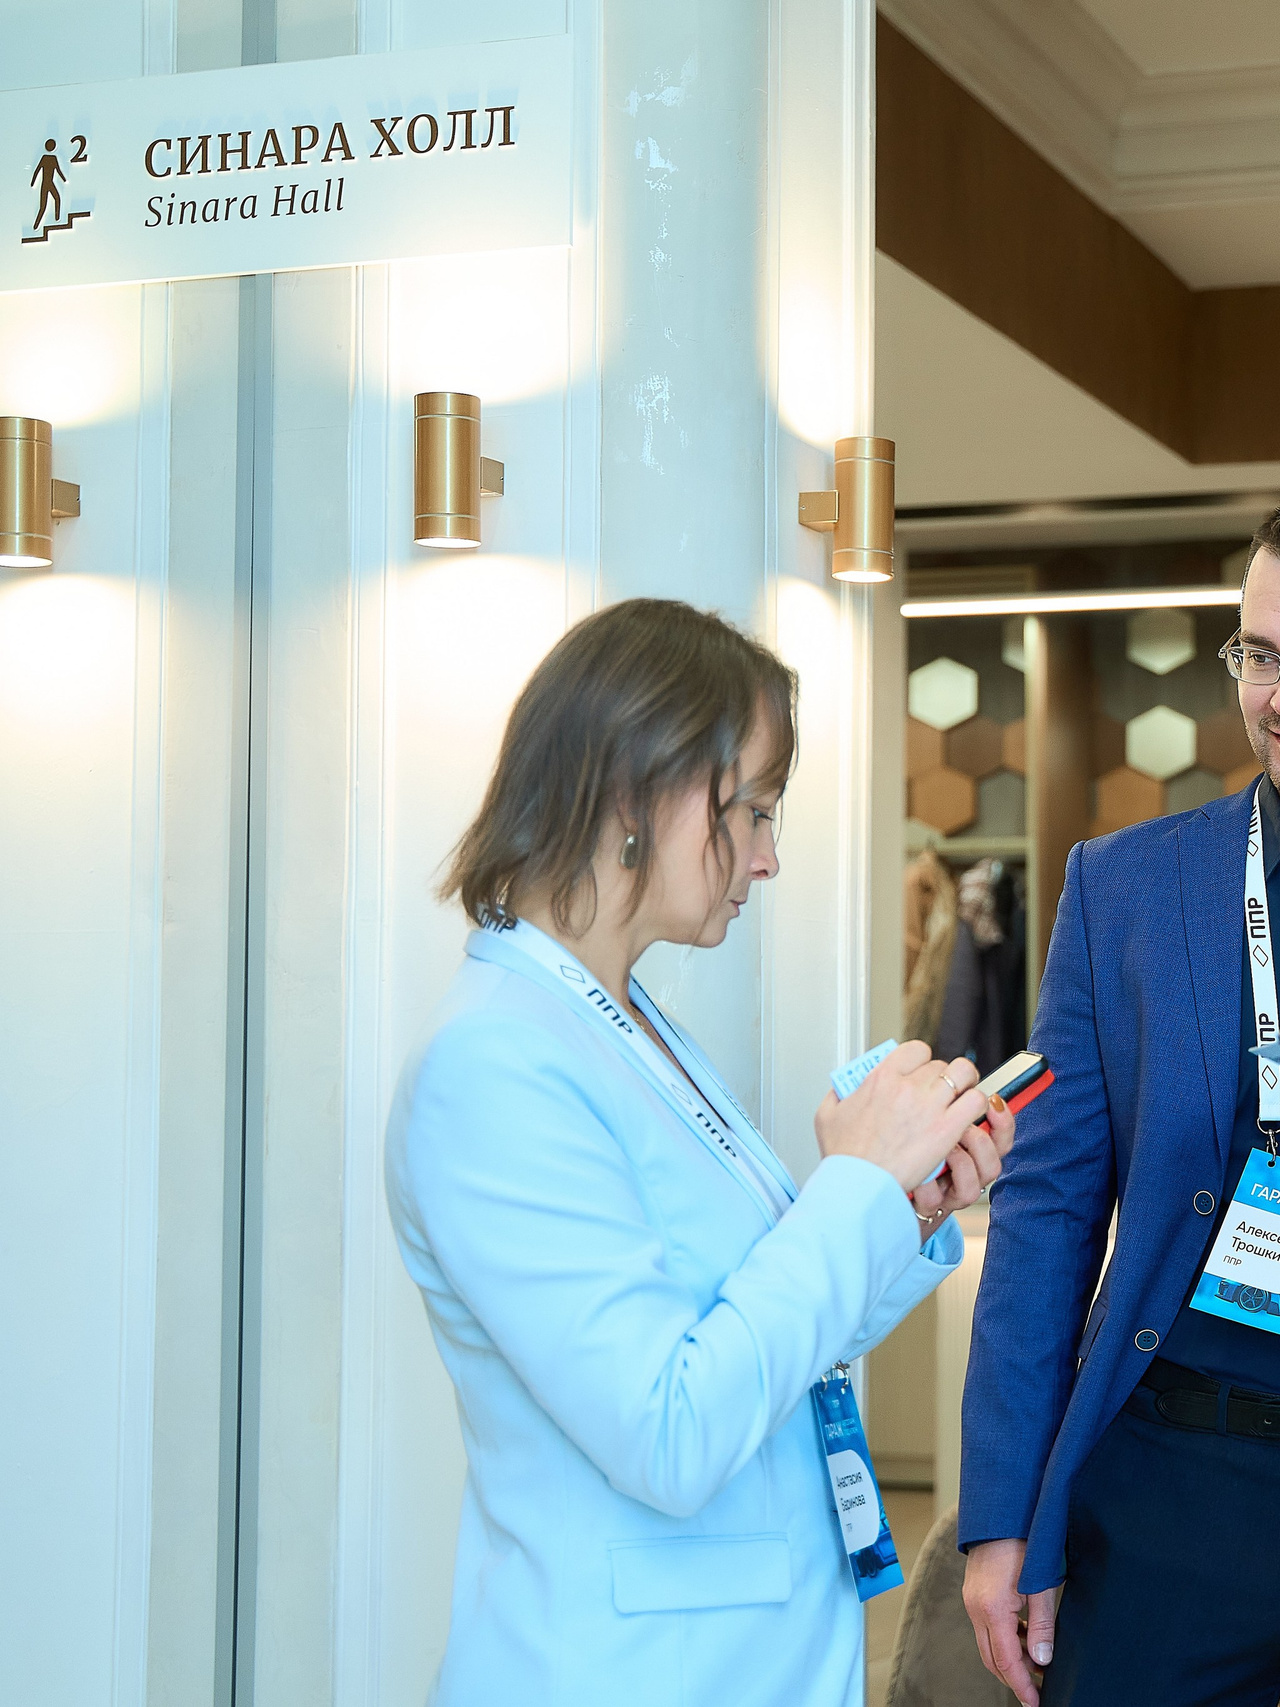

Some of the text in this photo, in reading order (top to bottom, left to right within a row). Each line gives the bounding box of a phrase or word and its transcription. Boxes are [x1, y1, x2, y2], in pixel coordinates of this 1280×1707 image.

[70, 135, 89, 163] 2
[144, 105, 516, 178] СИНАРА ХОЛЛ
[144, 177, 346, 228] Sinara Hall
[1248, 897, 1266, 939] ППР
[587, 988, 633, 1034] ППР
[1259, 1013, 1276, 1048] ПР
[696, 1111, 737, 1158] ППР
[1222, 1255, 1242, 1267] ППР
